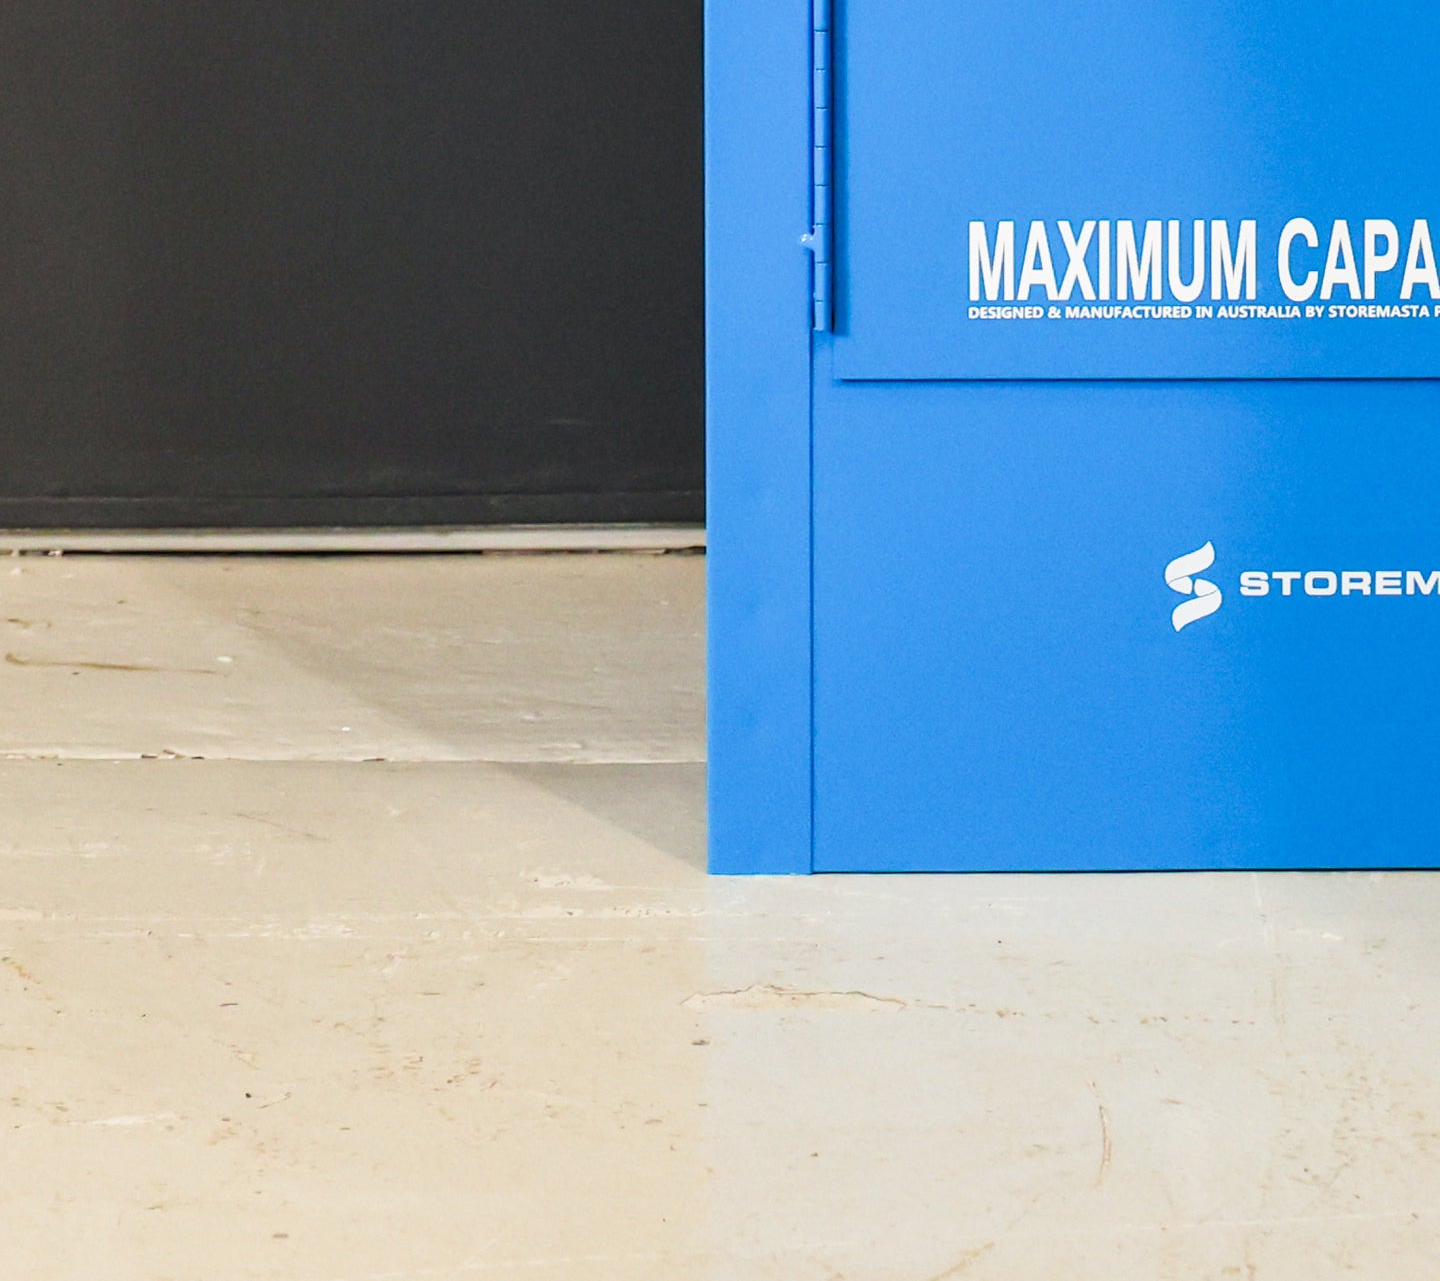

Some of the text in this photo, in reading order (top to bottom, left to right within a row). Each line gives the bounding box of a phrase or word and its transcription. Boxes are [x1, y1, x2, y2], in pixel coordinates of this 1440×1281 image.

[968, 219, 1257, 303] MAXIMUM
[968, 306, 1045, 319] DESIGNED
[1047, 306, 1062, 319] &
[1065, 306, 1193, 319] MANUFACTURED
[1195, 305, 1213, 318] IN
[1216, 305, 1301, 318] AUSTRALIA
[1305, 305, 1325, 318] BY
[1328, 305, 1430, 318] STOREMASTA
